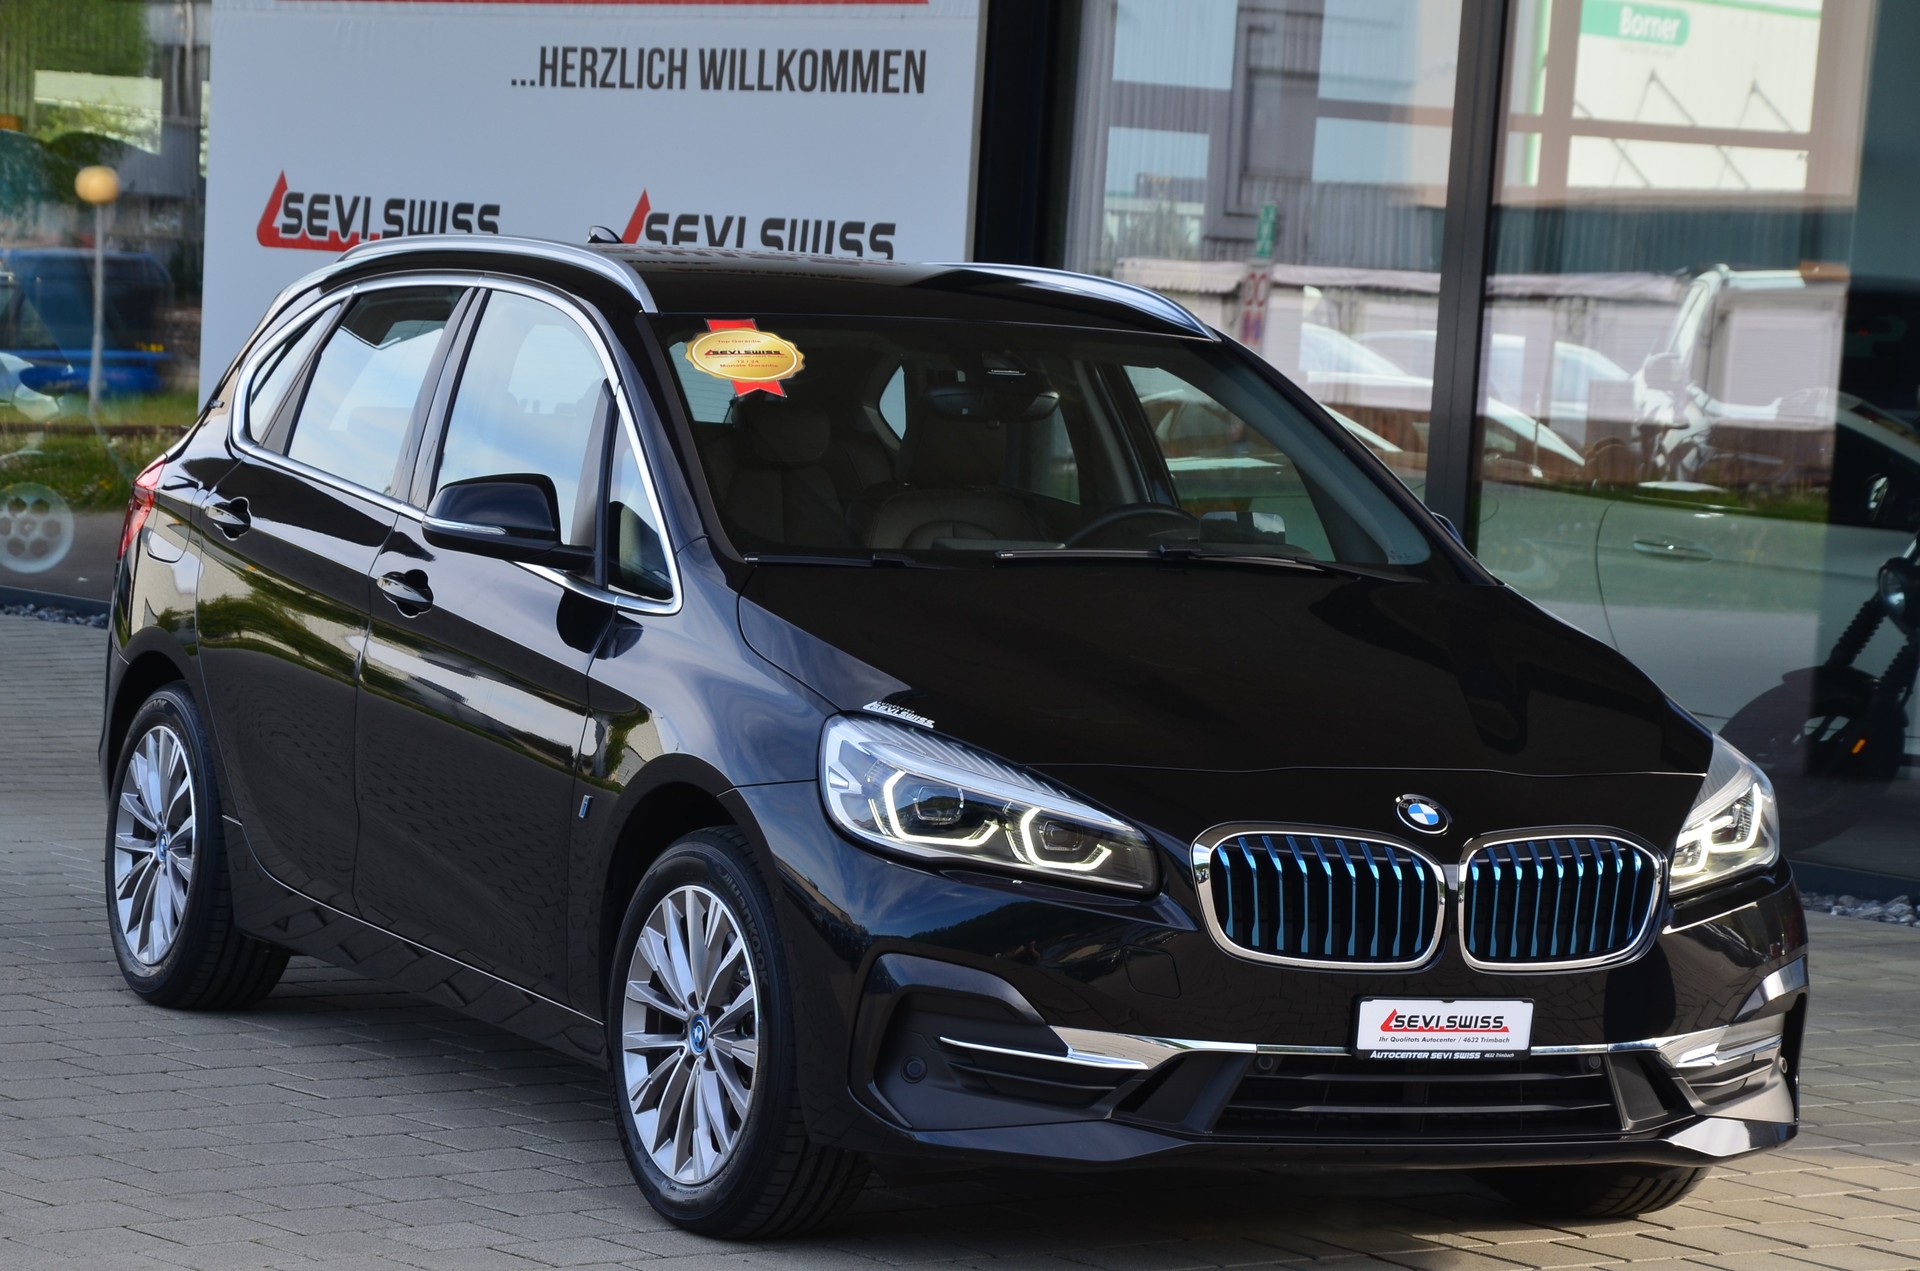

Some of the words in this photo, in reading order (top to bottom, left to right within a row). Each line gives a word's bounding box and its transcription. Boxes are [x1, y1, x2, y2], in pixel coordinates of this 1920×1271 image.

[1620, 5, 1681, 41] Borner
[511, 46, 688, 90] ...HERZLICH
[699, 48, 927, 94] WILLKOMMEN
[281, 191, 372, 241] SEVI
[382, 198, 500, 240] SWISS
[1394, 1015, 1441, 1028] SEVI
[1446, 1015, 1504, 1028] SWISS
[1481, 1036, 1510, 1044] Trimbach
